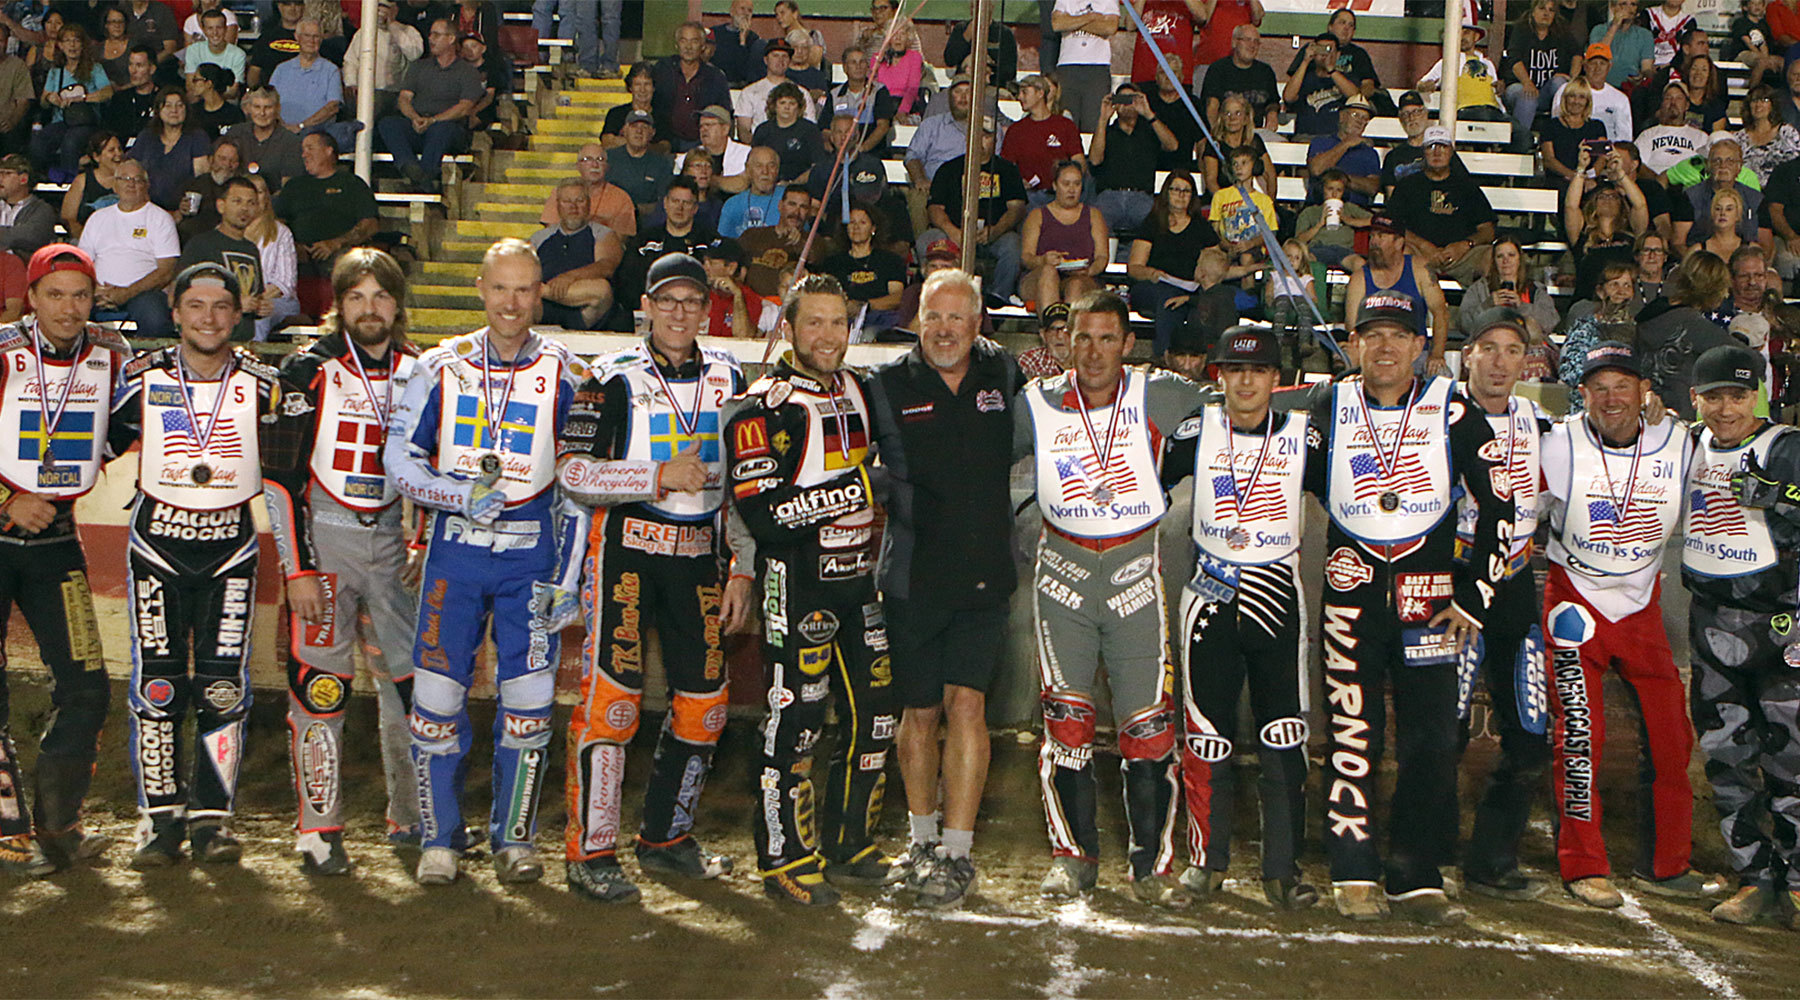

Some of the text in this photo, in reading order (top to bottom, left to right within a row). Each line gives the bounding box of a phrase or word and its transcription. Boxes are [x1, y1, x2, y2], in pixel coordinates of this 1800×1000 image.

[1530, 49, 1559, 69] LOVE
[1652, 135, 1694, 150] NEVADA
[15, 354, 26, 372] 6
[332, 371, 342, 389] 4
[535, 376, 546, 393] 3
[234, 386, 244, 404] 5
[714, 389, 724, 407] 2
[1120, 407, 1138, 425] 1N
[1340, 407, 1360, 424] 3N
[1054, 425, 1083, 445] Fast
[1517, 417, 1532, 435] 4N
[1278, 437, 1297, 455] 2N
[38, 472, 81, 484] NOR CAL
[161, 461, 189, 480] Fast
[589, 464, 649, 477] Severin
[1653, 460, 1674, 479] 5N
[584, 475, 649, 492] Recycling
[152, 502, 241, 527] HAGON
[1049, 501, 1150, 520] North vs South
[1400, 499, 1441, 517] South
[149, 521, 239, 541] SHOCKS
[1255, 531, 1291, 548] South
[623, 537, 655, 554] Skog
[1572, 533, 1609, 555] North
[1614, 546, 1628, 559] vs
[1684, 535, 1757, 562] orth vs South
[1106, 576, 1155, 611] WAGNER
[1194, 573, 1235, 601] LAKE
[137, 578, 155, 648] MIKE
[1117, 589, 1156, 618] FAMILY
[150, 574, 170, 656] KELLY
[412, 715, 457, 739] NGK
[506, 715, 551, 736] NGK
[1323, 604, 1371, 843] WARNOCK
[142, 719, 163, 796] HAGON
[160, 721, 177, 795] SHOCKS
[1053, 755, 1087, 771] FAMILY
[1563, 756, 1592, 822] SUPPLY
[766, 799, 784, 854] Logistics
